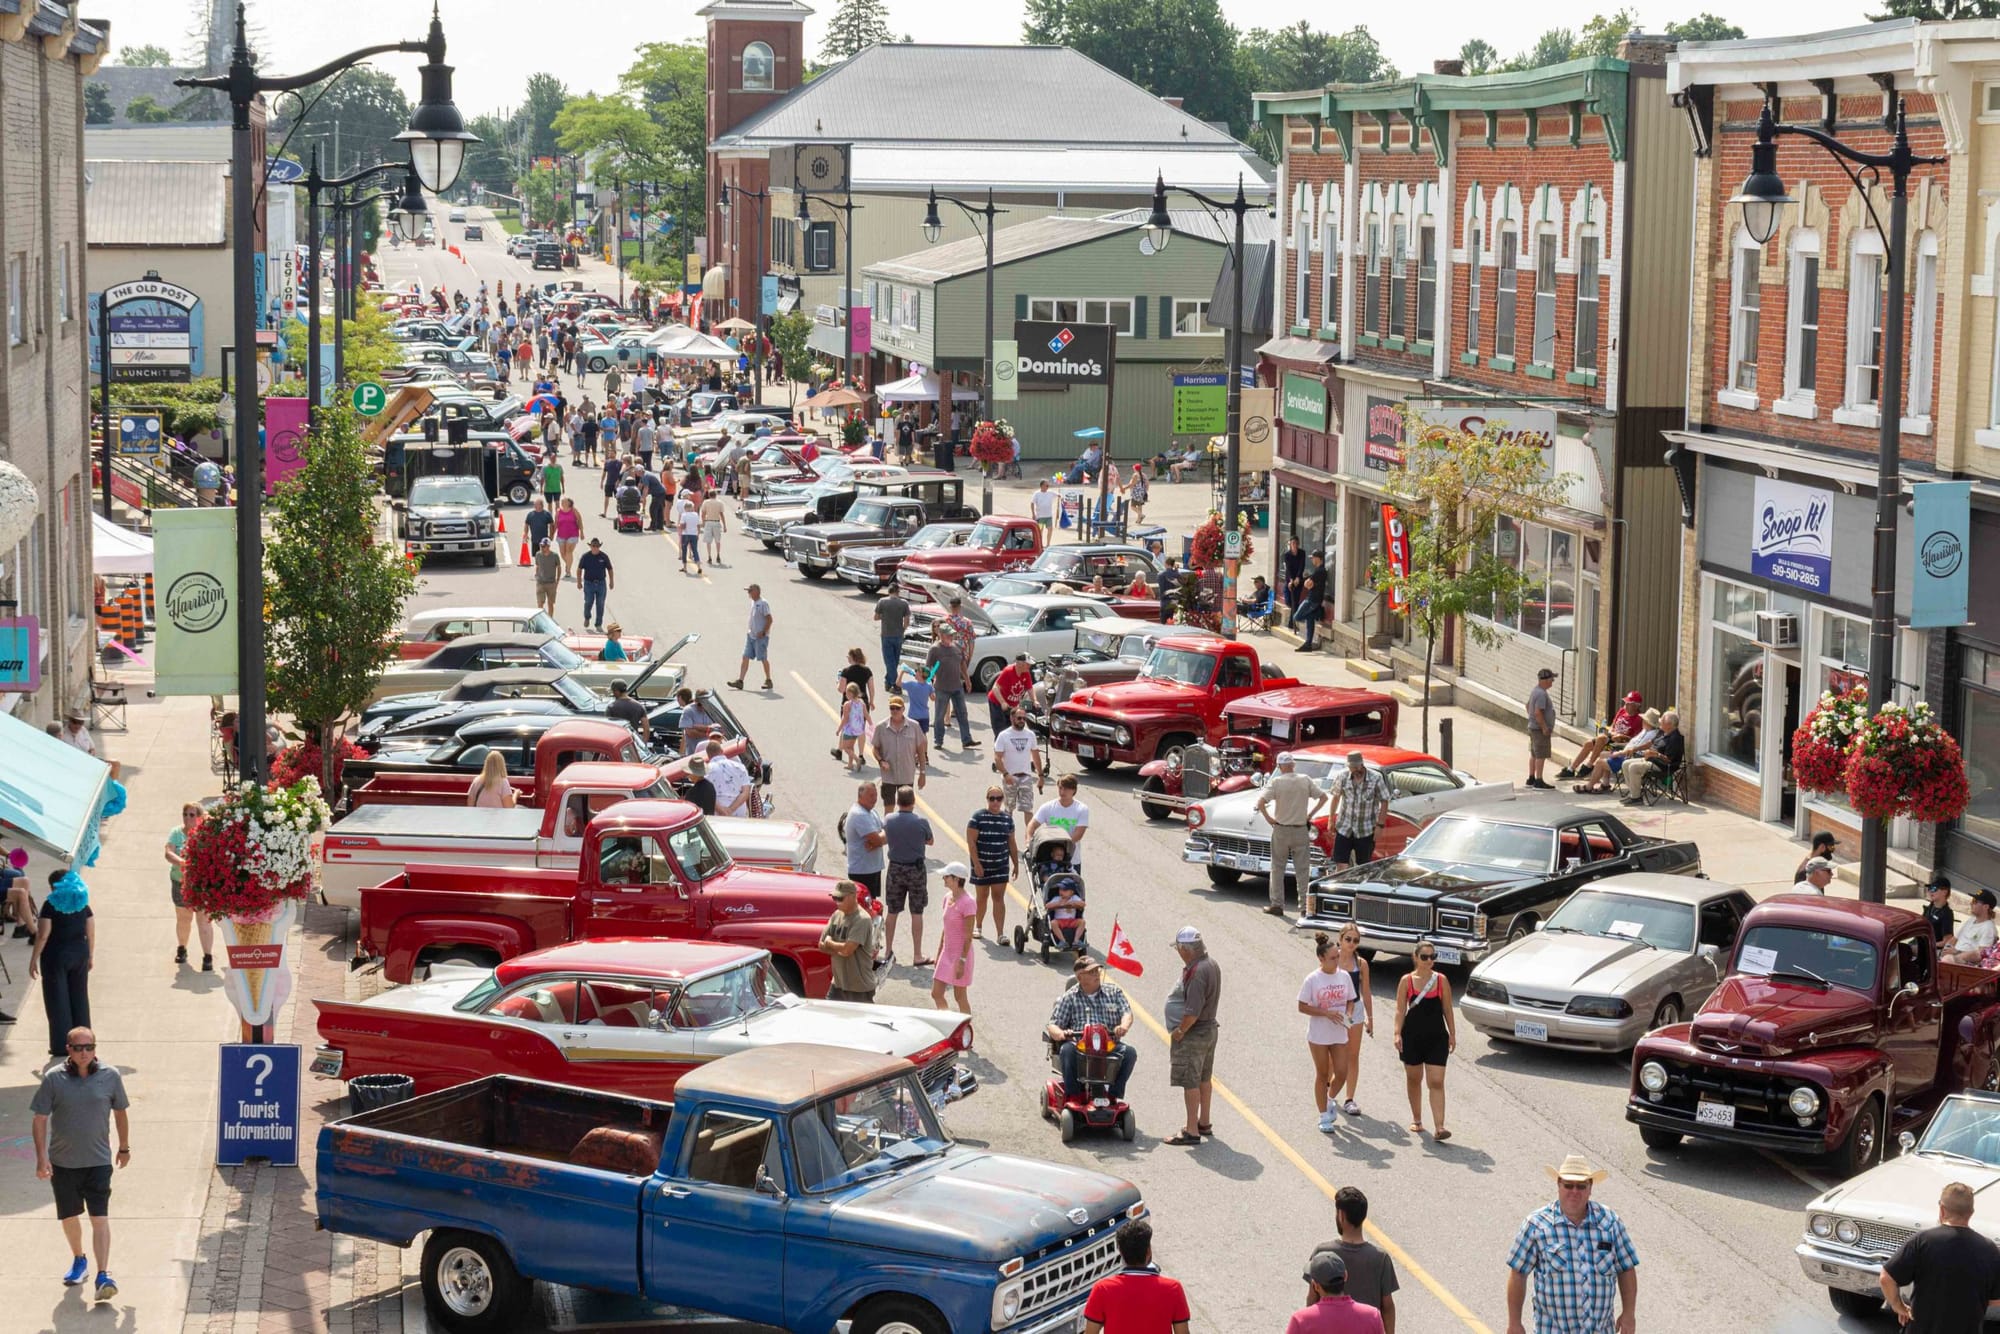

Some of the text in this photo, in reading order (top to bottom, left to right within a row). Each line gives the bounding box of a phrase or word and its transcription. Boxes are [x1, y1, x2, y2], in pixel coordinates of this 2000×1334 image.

[284, 253, 293, 300] Legion
[113, 285, 188, 301] THE OLD POST
[1018, 358, 1102, 376] Domino's
[1183, 376, 1217, 384] Harriston
[362, 387, 377, 403] P
[1287, 392, 1323, 415] ServiceOntario
[1762, 502, 1826, 546] Scoop It!
[1922, 542, 1961, 568] Harriston
[1772, 564, 1820, 587] 519-510-2855
[166, 586, 225, 621] Harriston
[238, 1100, 281, 1119] Tourist
[224, 1121, 293, 1140] Information
[1039, 1218, 1117, 1258] FORD
